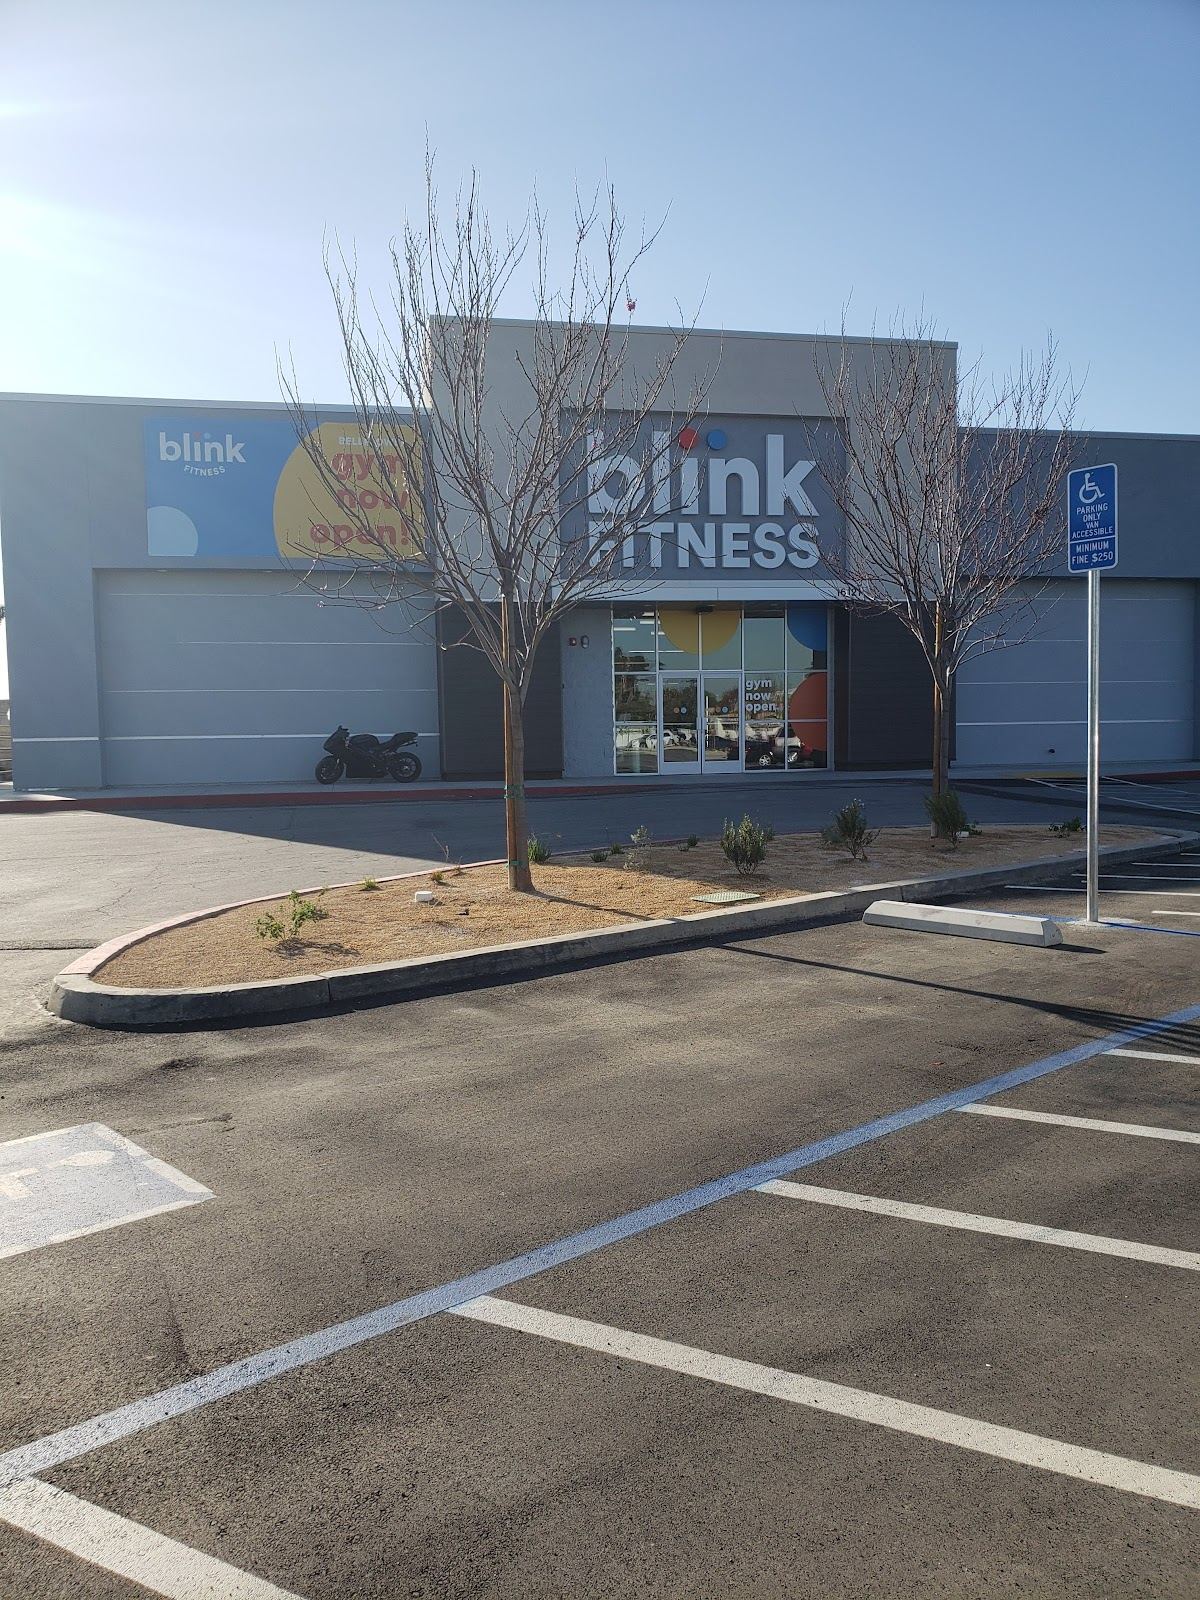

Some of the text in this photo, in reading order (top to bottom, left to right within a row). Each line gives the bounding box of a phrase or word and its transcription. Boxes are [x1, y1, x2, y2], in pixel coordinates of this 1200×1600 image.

[160, 431, 246, 463] blink
[184, 465, 225, 476] FITNESS
[587, 427, 819, 516] blink
[1076, 503, 1108, 515] PARKING
[1083, 513, 1101, 522] ONLY
[1086, 521, 1099, 529] VAN
[1072, 526, 1113, 538] ACCESSIBLE
[588, 522, 820, 569] FITNESS
[1076, 541, 1109, 553] MINIMUM
[1072, 552, 1113, 565] FINE $250
[746, 679, 772, 691] gym
[746, 692, 771, 701] now
